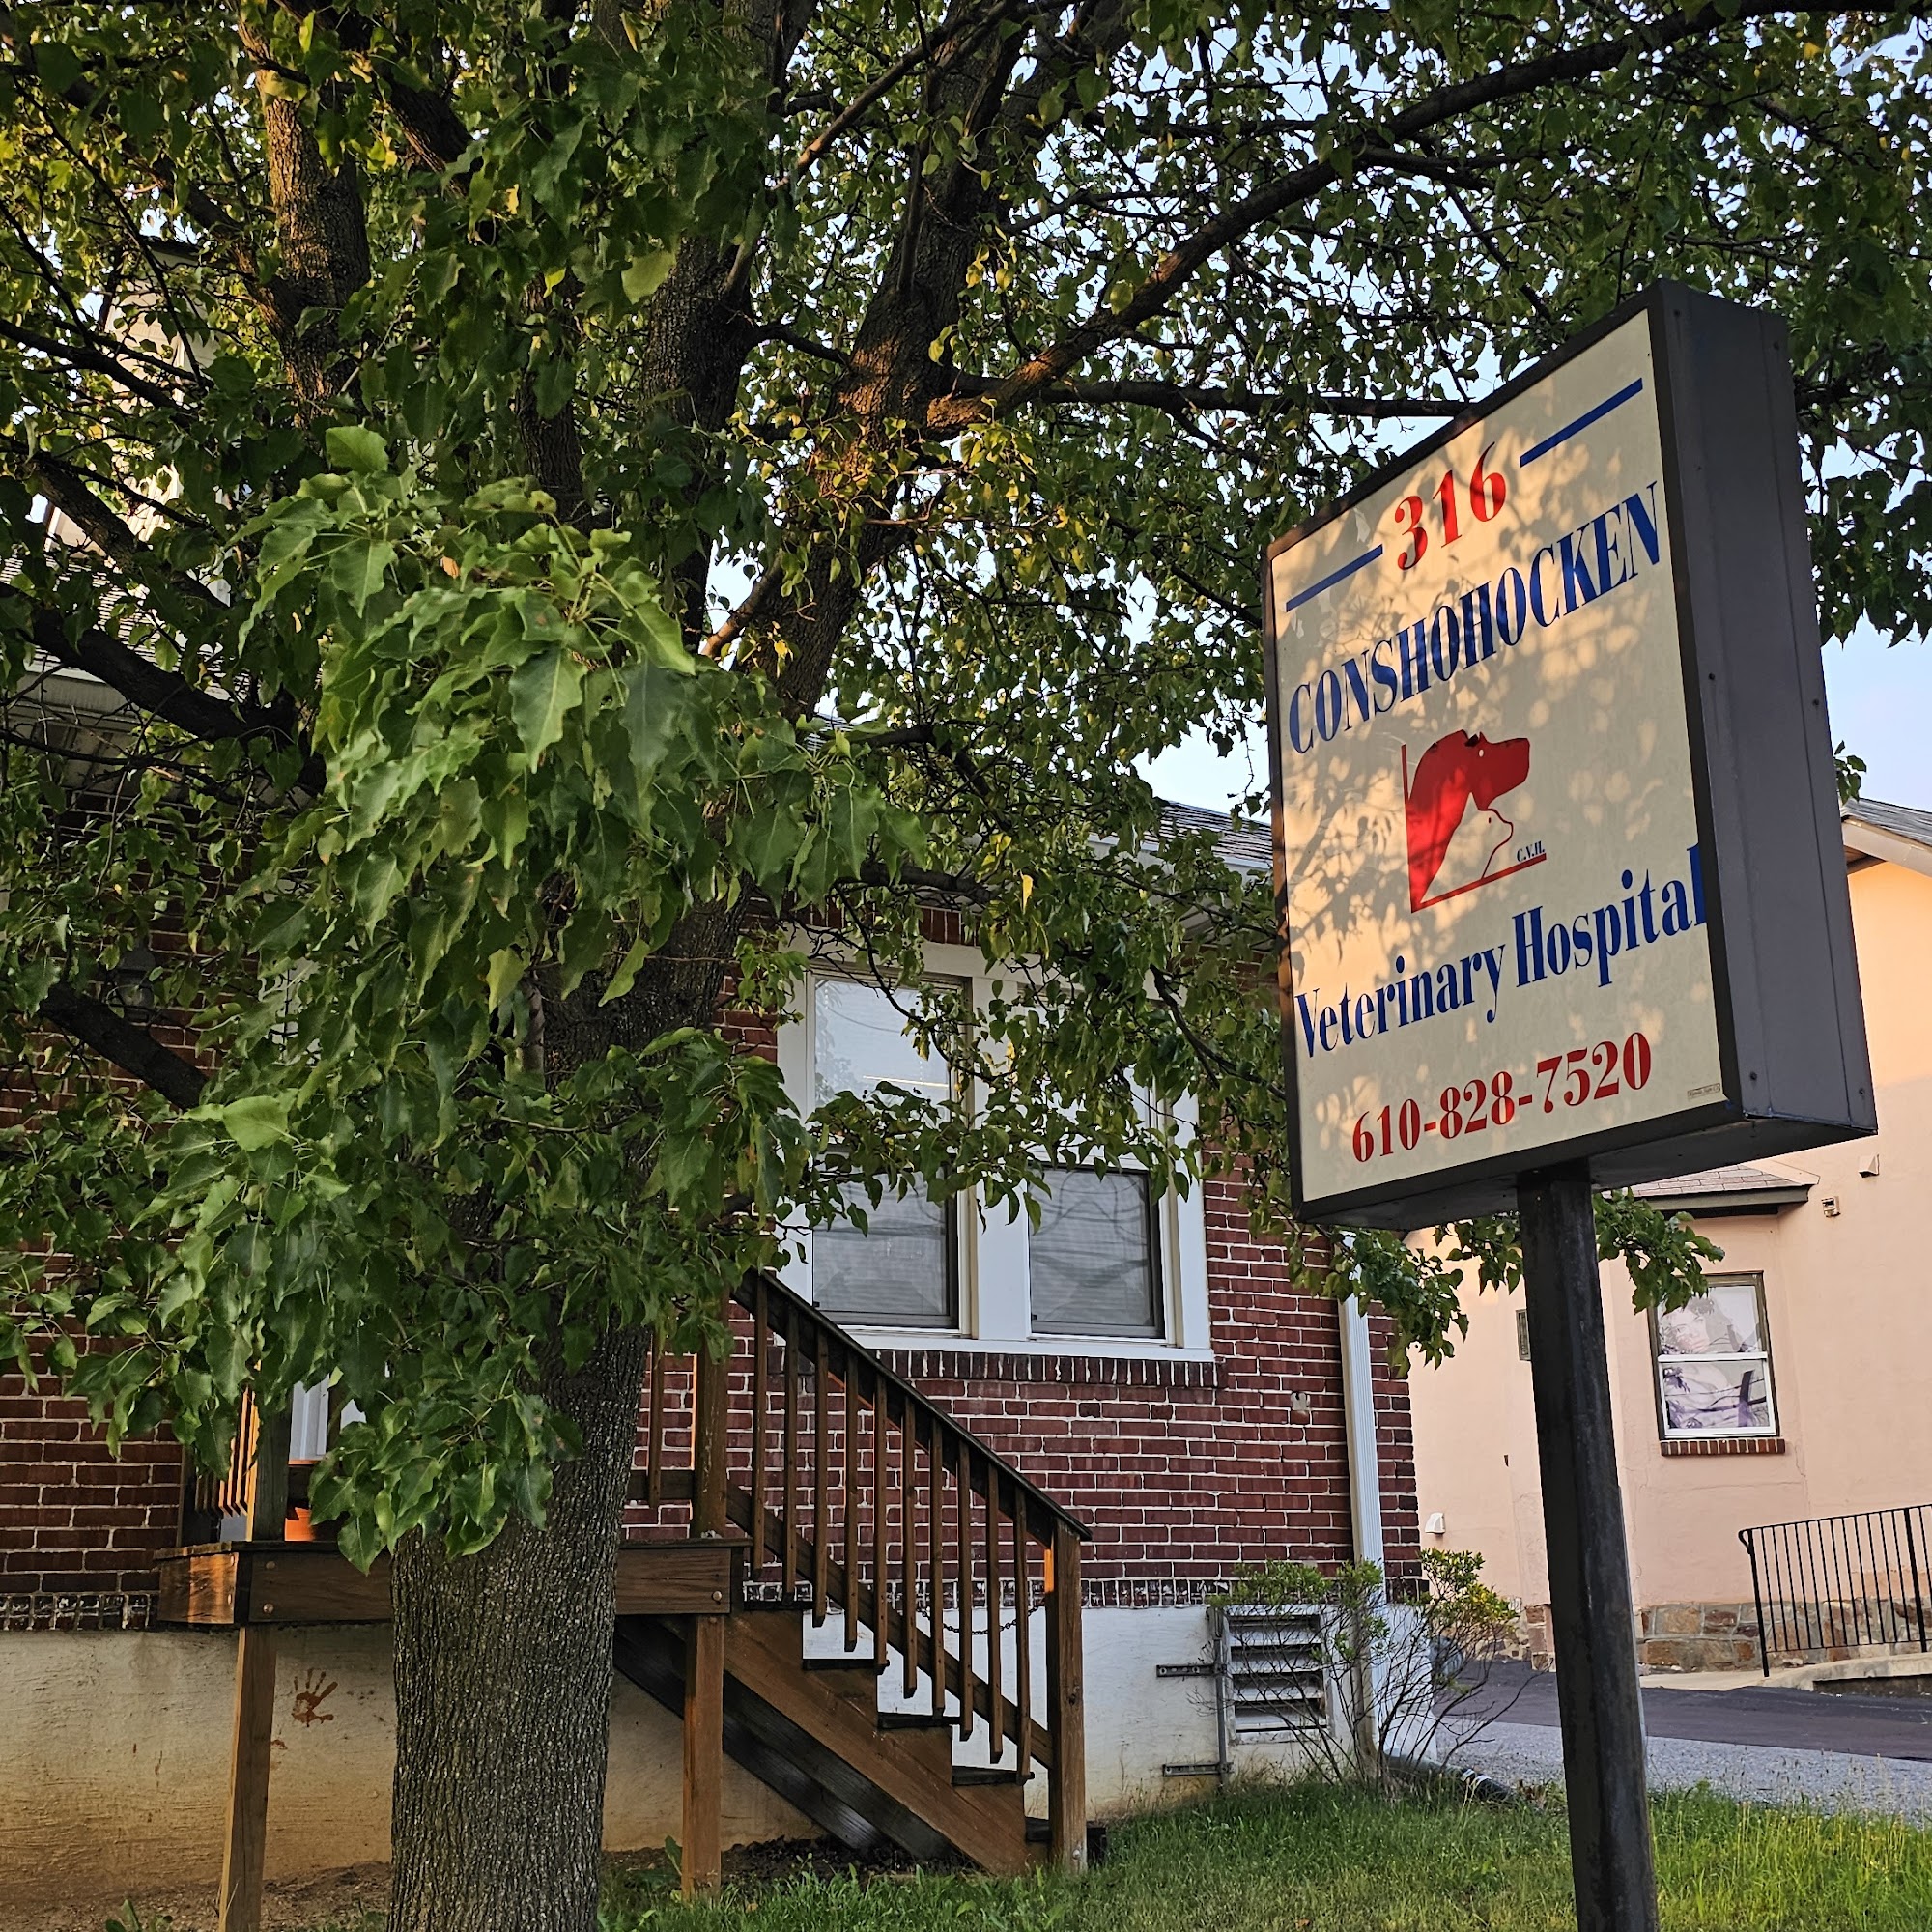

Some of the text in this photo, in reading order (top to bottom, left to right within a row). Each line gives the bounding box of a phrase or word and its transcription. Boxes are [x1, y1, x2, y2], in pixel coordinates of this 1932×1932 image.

[1394, 442, 1507, 571] 316
[1289, 480, 1661, 754] CONSHOHOCKEN
[1295, 842, 1707, 1058] Veterinary Hospital
[1352, 1032, 1651, 1162] 610-828-7520
